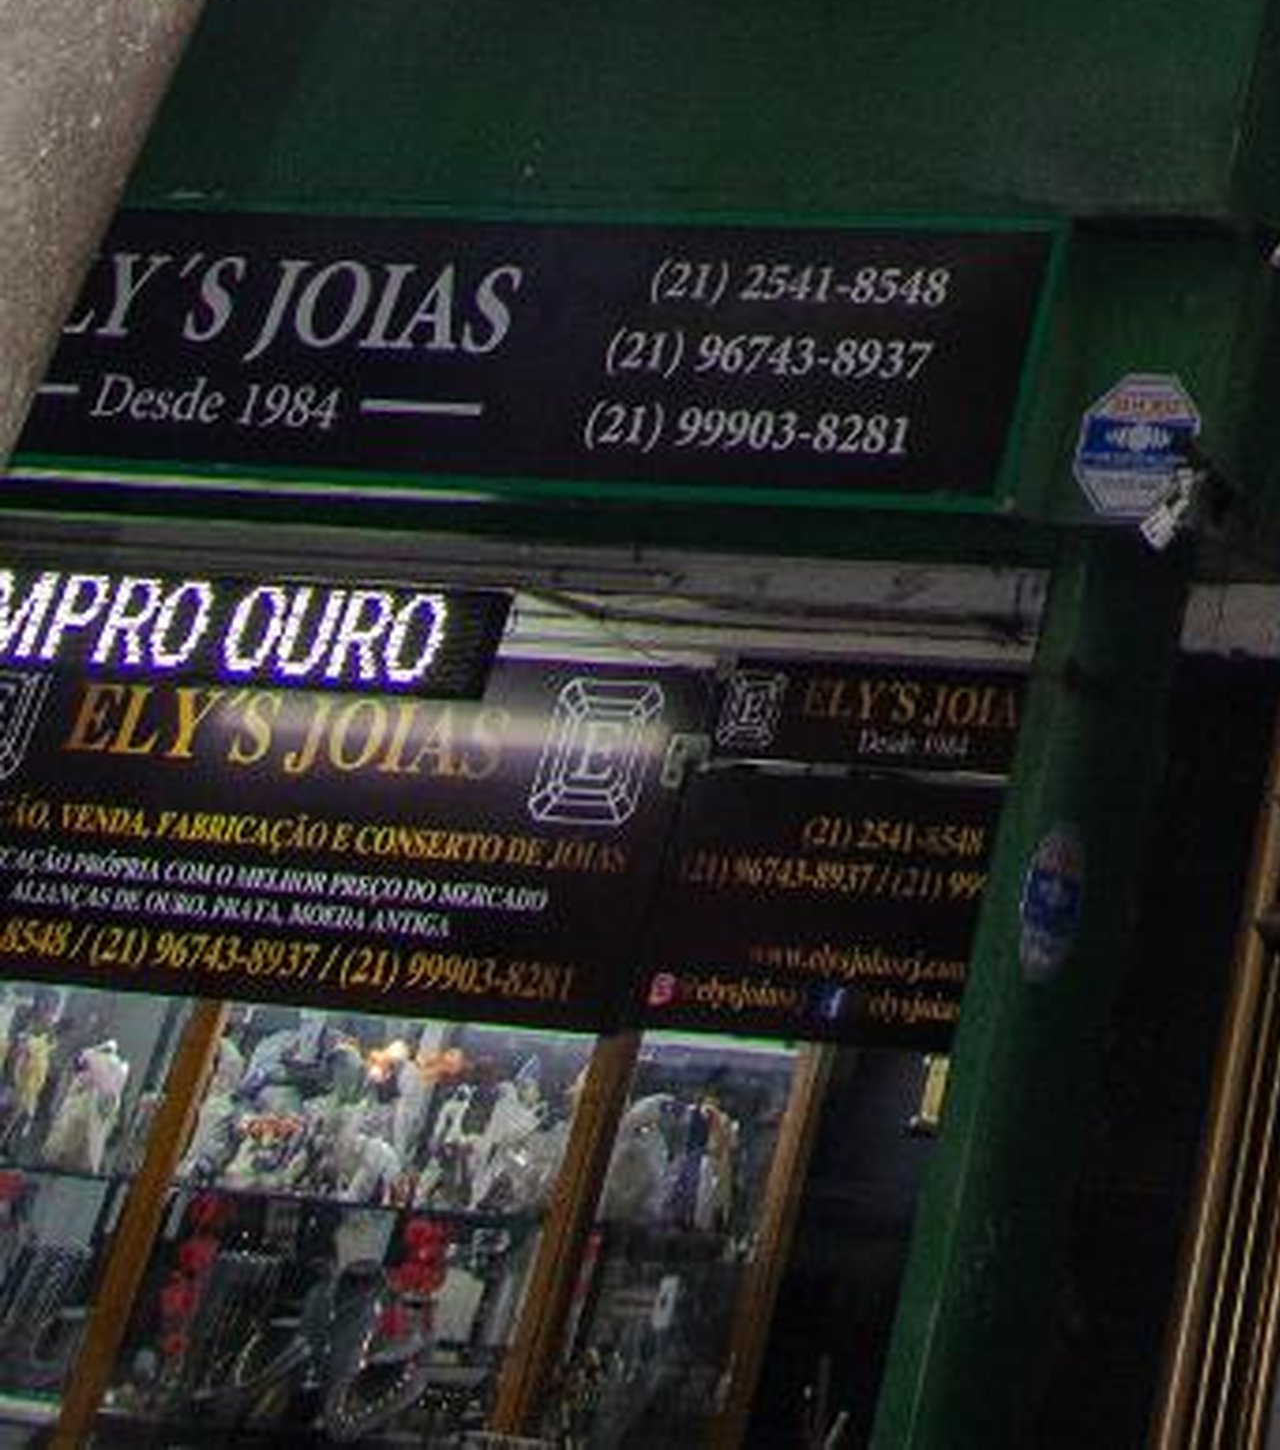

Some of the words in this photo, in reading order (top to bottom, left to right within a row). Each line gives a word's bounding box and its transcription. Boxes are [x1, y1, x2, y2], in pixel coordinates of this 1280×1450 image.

[243, 260, 523, 362] JOIAS
[650, 259, 730, 308] (21)
[740, 263, 950, 308] 2541-8548
[605, 327, 685, 378] (21)
[694, 334, 934, 380] 96743-8937
[89, 374, 225, 424] Desde
[237, 382, 342, 430] 1984
[584, 401, 665, 453] (21)
[674, 406, 910, 454] 99903-8281
[223, 583, 446, 684] OURO
[286, 694, 509, 779] JOIAS
[154, 810, 328, 855] FABRICAÇÃO
[331, 824, 350, 852] E
[356, 824, 501, 861] CONSERTO
[504, 835, 543, 866] DE
[89, 926, 150, 968] (21)
[152, 930, 321, 980] 96743-8937
[339, 946, 399, 993] (21)
